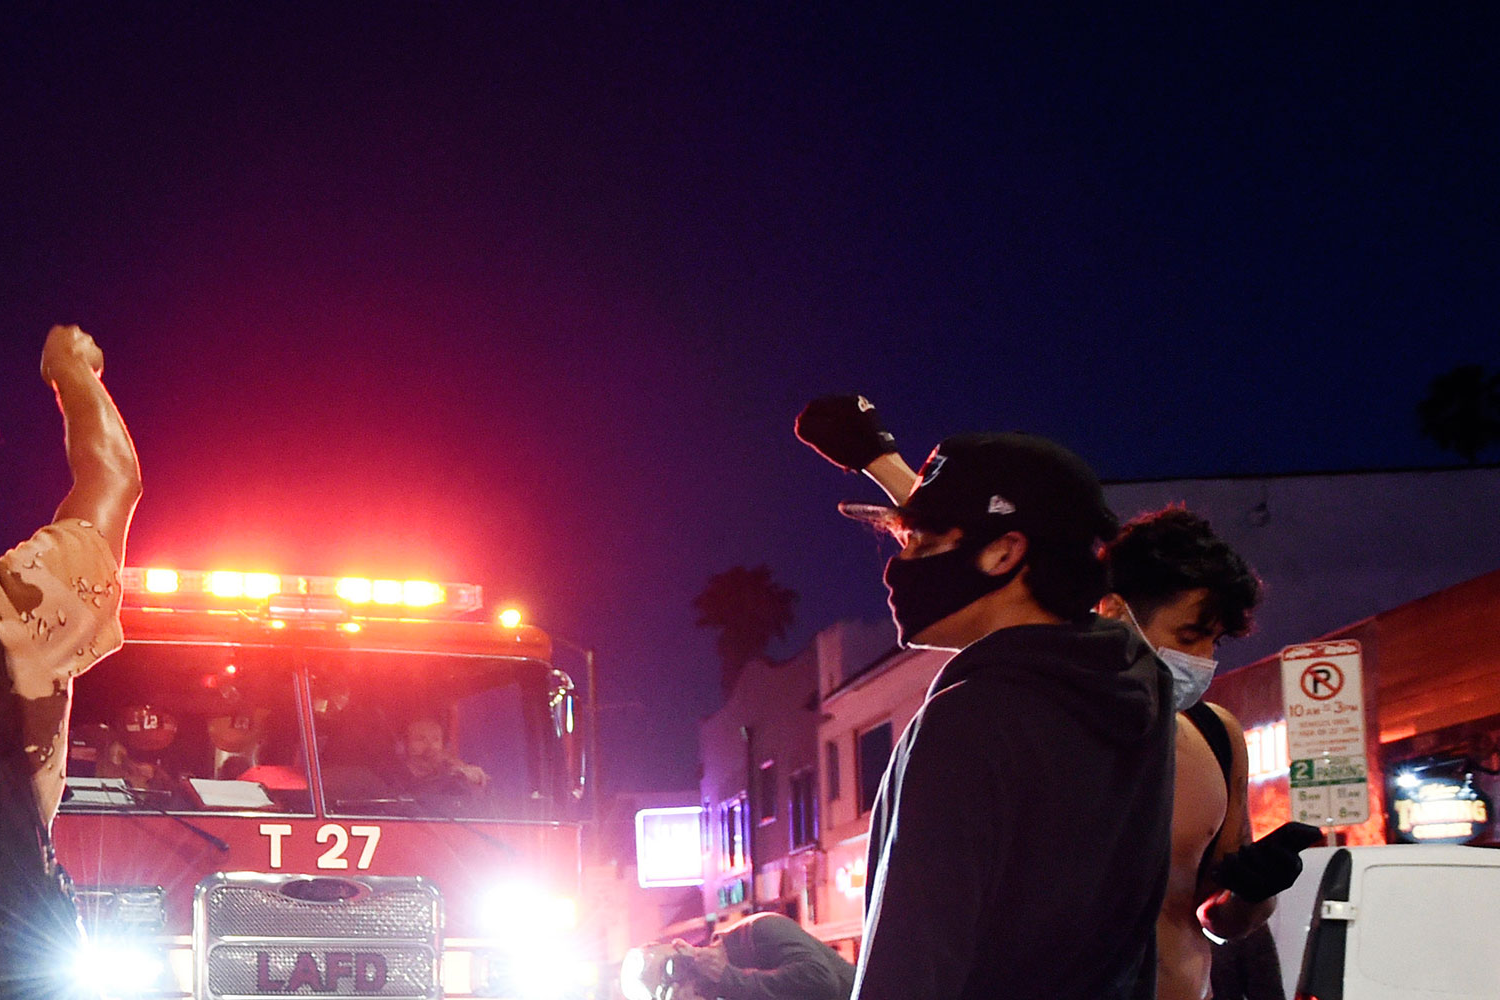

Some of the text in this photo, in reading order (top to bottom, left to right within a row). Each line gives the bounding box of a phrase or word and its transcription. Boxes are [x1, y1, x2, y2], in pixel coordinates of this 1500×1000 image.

[1294, 762, 1309, 779] 2
[259, 823, 382, 870] T 27
[256, 951, 389, 993] LAFD
